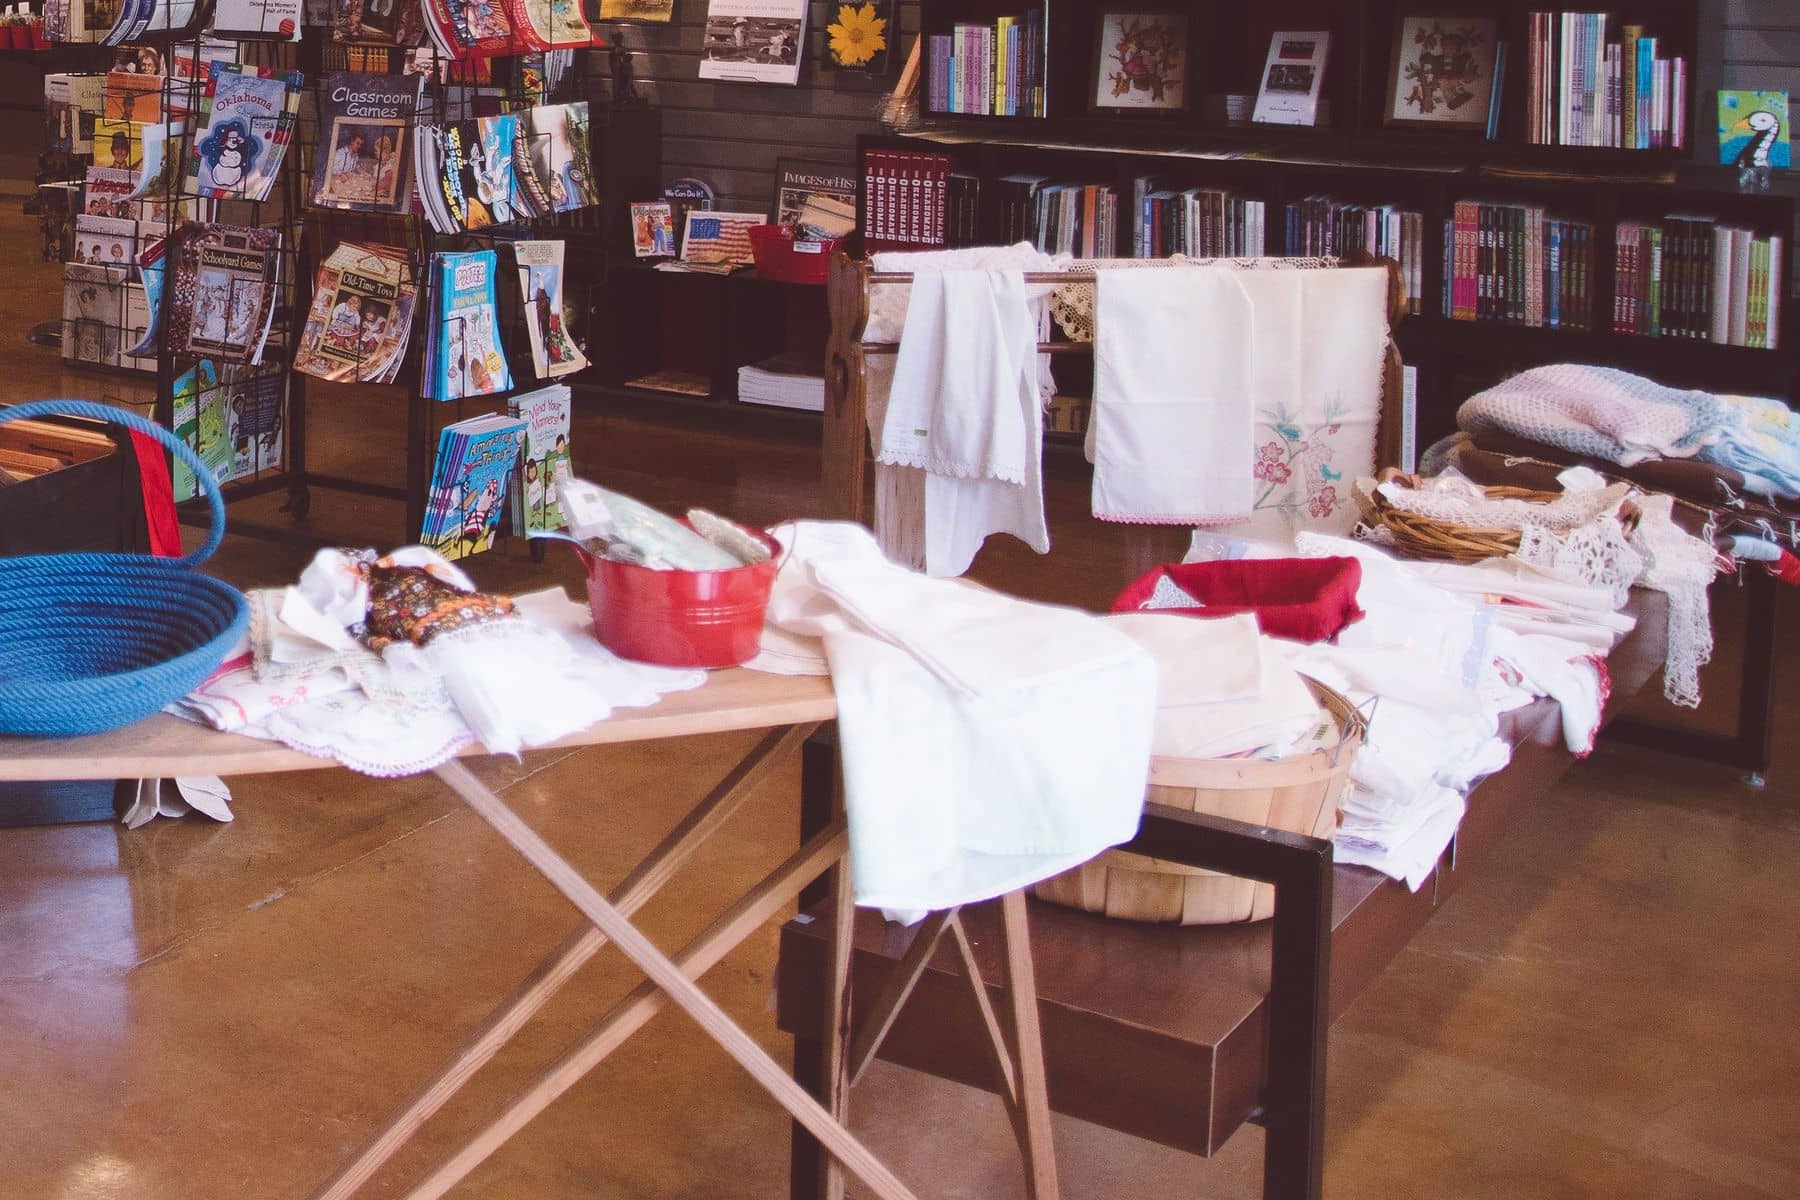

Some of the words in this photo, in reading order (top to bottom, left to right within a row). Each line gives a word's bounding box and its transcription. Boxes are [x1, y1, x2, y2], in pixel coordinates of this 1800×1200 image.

[216, 92, 272, 111] Oklahoma
[332, 86, 412, 104] Classroom
[347, 102, 398, 118] Games
[784, 171, 823, 186] IMAGES
[664, 190, 675, 198] We
[675, 190, 687, 198] Can
[240, 257, 263, 272] Games
[343, 273, 377, 292] Old-Time
[378, 285, 395, 298] Toys
[529, 403, 546, 419] Mind
[548, 399, 562, 414] Your
